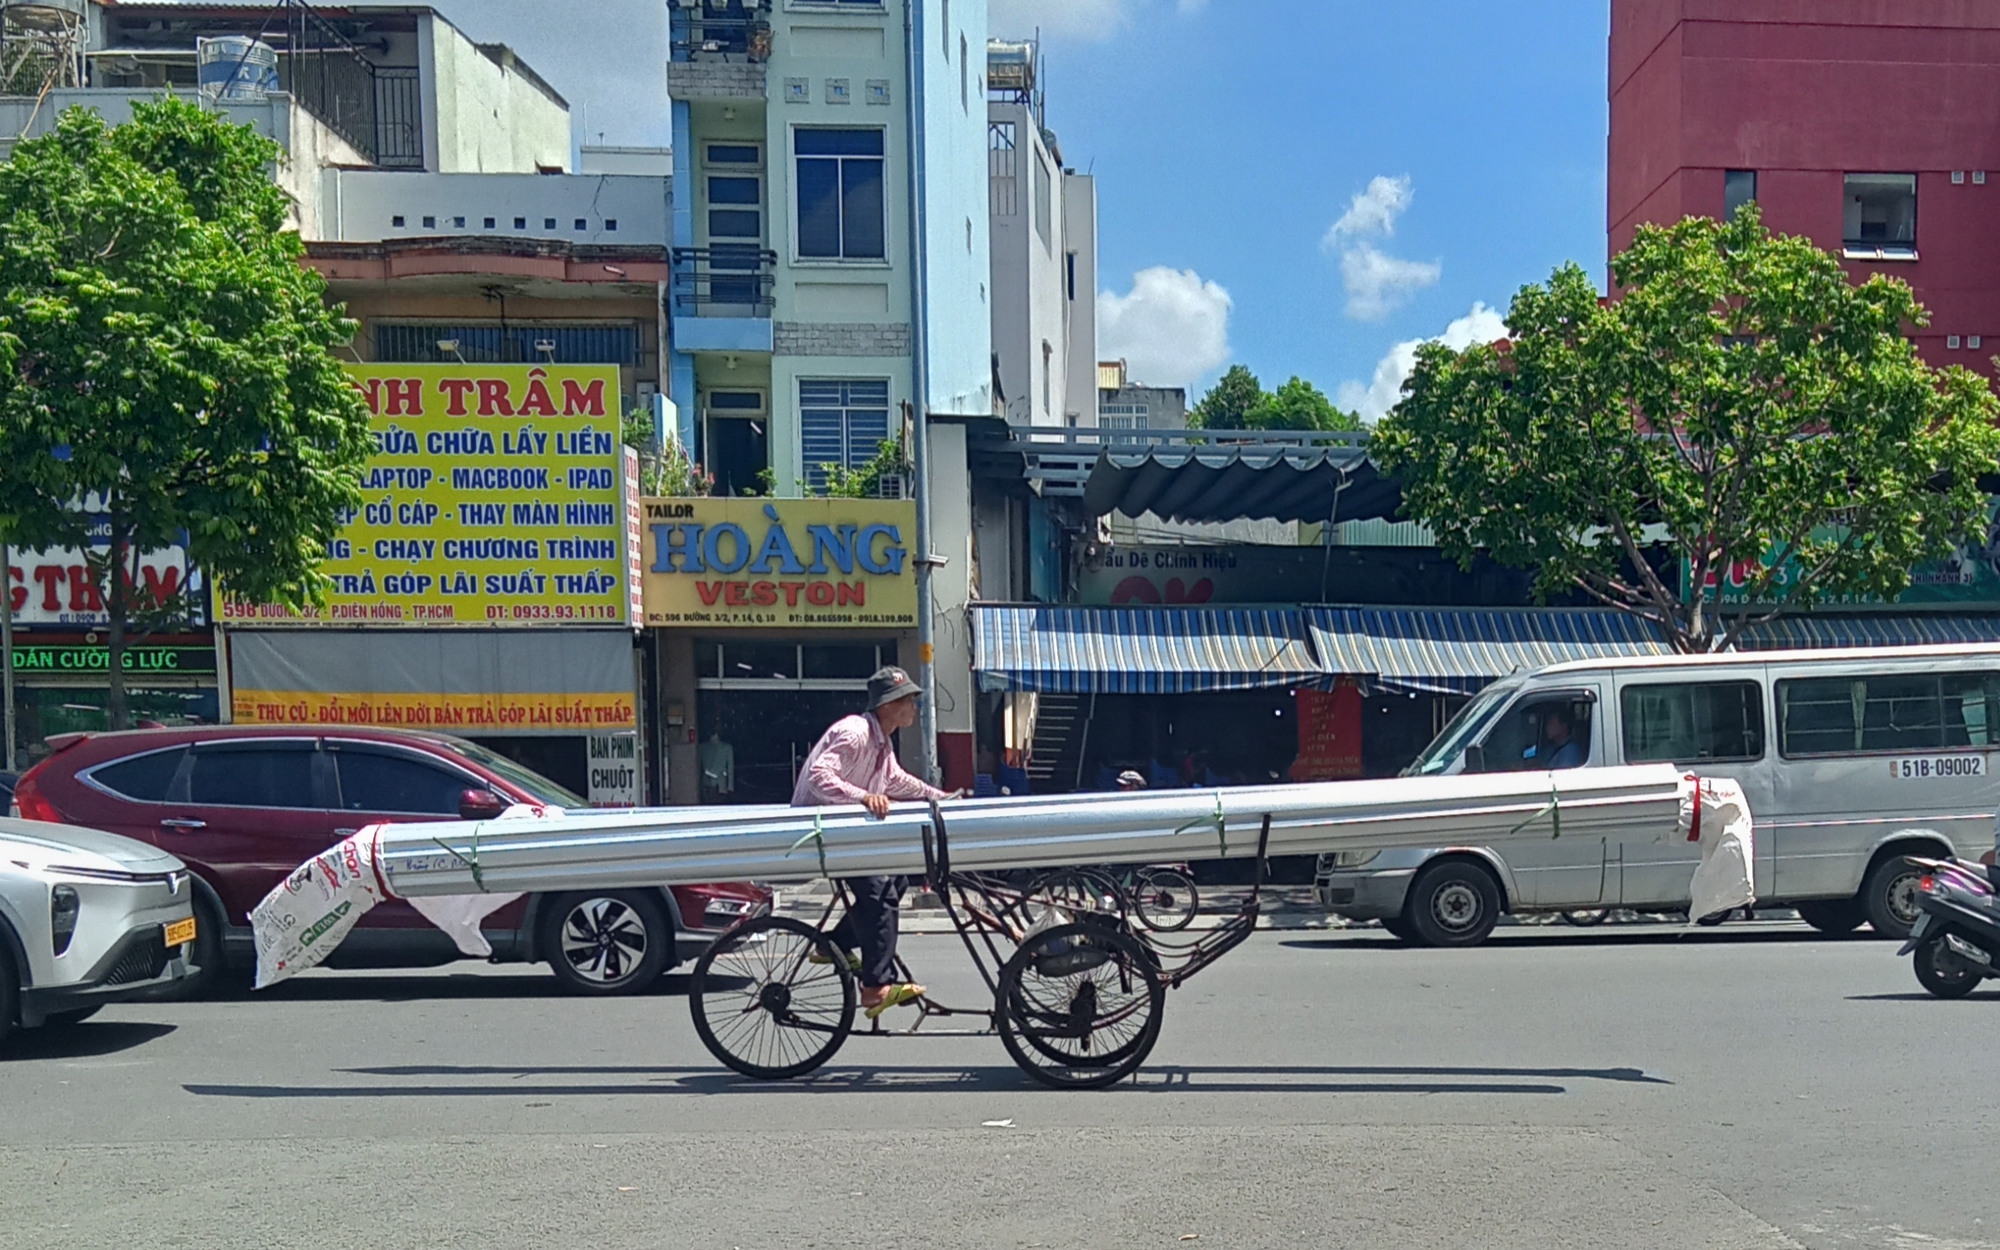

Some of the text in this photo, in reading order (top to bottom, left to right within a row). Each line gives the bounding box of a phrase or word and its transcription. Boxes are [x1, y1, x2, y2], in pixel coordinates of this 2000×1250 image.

[438, 367, 607, 416] TRÂM
[370, 425, 418, 455] SỬA
[427, 427, 495, 455] CHỮA
[503, 424, 548, 455] LẤY
[557, 425, 612, 455] LIỀN
[452, 468, 549, 490] MACBOOK
[569, 468, 613, 490] IPAD
[365, 495, 393, 526] CỔ
[398, 498, 438, 526] CÁP
[459, 503, 506, 526] THAY
[513, 499, 559, 526] MÀN
[565, 499, 614, 526] HÌNH
[645, 503, 694, 518] TAILOR
[374, 540, 436, 563] CHẠY
[444, 537, 539, 560] CHƯƠNG
[546, 535, 616, 560] TRÌNH
[649, 503, 907, 575] HOÀNG
[1129, 551, 1149, 568] Dê
[329, 568, 616, 594] TRẢ GÓP LÃI SUẤT THẤP
[695, 580, 865, 607] VESTON
[223, 602, 257, 618] 598
[413, 605, 454, 619] TP.HCM
[513, 605, 616, 619] 0933.93.1118
[13, 649, 53, 668] DÁN
[140, 648, 178, 672] LỰC
[256, 703, 285, 722] THU
[289, 700, 308, 722] CŨ
[319, 697, 344, 723] ĐỔI
[347, 701, 373, 723] MỚI
[377, 701, 402, 724] LÊN
[434, 702, 463, 724] BÁN
[467, 700, 495, 724] TRẢ
[498, 703, 526, 724] GÓP
[529, 702, 552, 724] LÃI
[555, 699, 592, 724] SUẤT
[594, 699, 632, 724] THẤP
[591, 764, 635, 793] CHUỘT
[1902, 757, 1981, 777] 51B-09002
